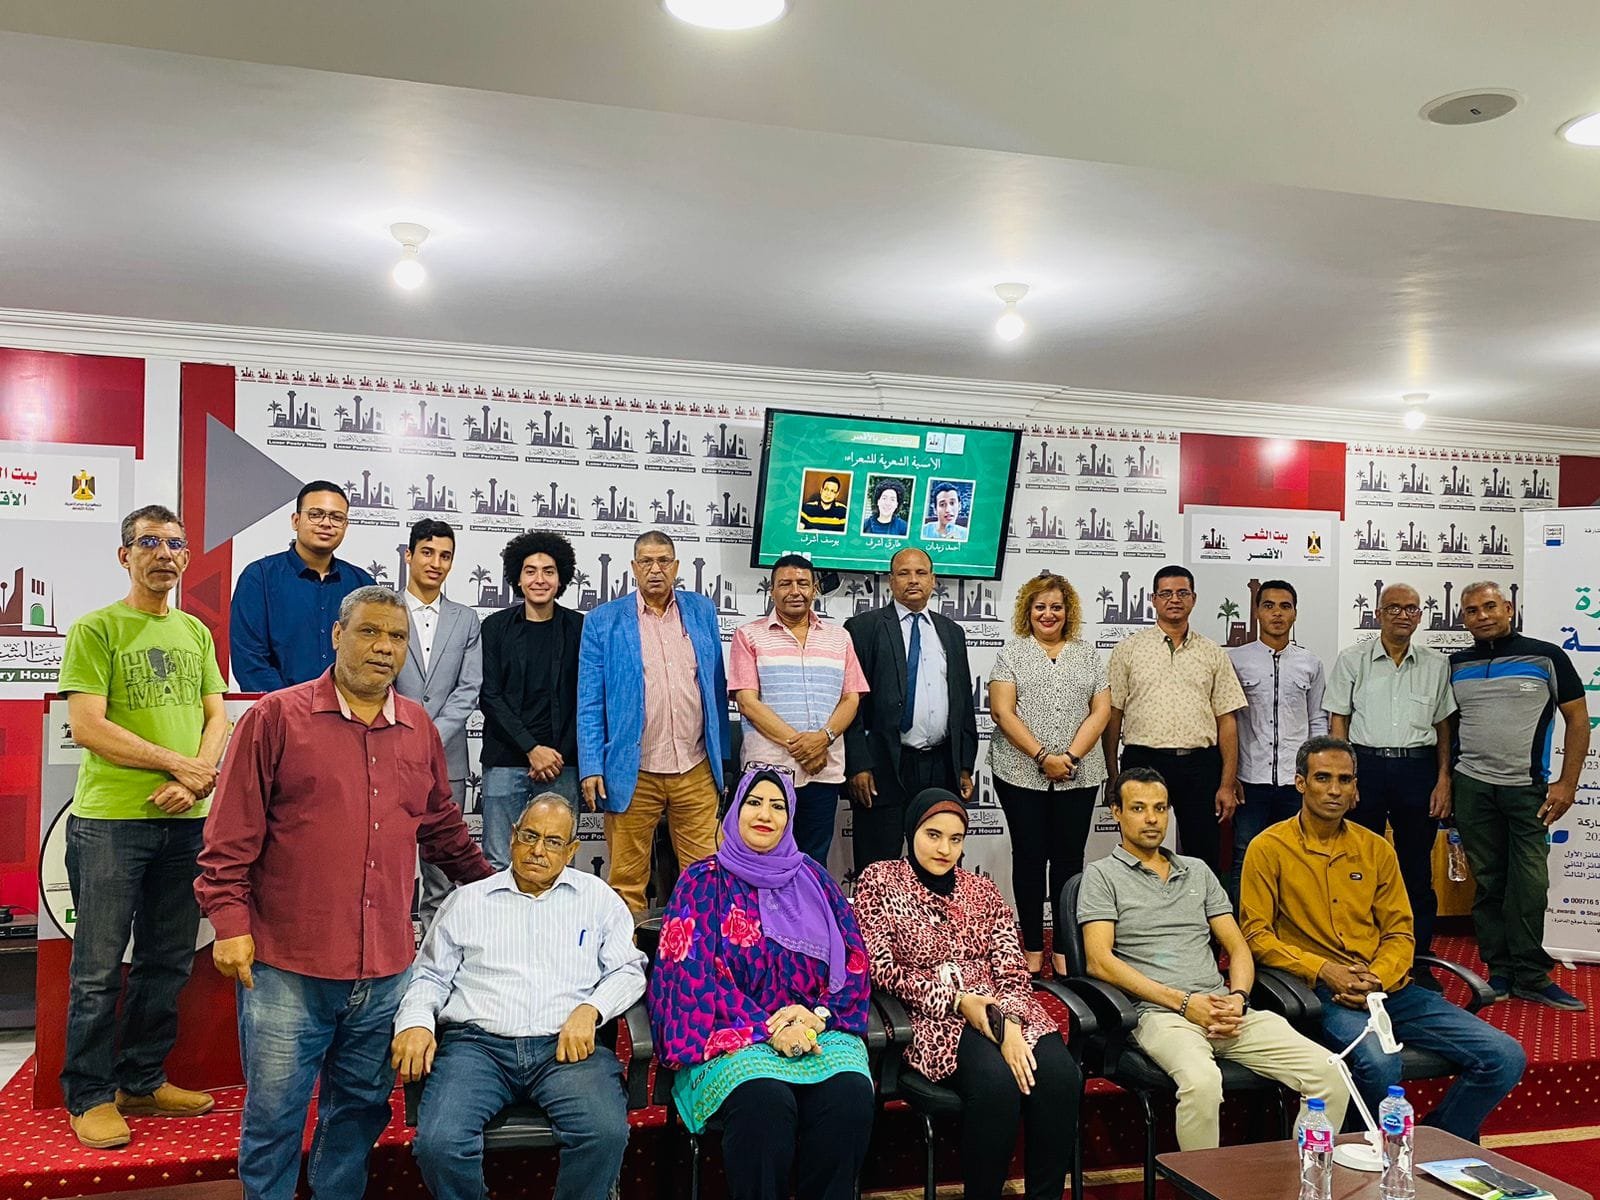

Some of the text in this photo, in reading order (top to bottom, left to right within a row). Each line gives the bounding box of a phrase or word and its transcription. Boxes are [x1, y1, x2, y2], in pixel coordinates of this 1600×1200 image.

[11, 467, 38, 486] بيت
[0, 490, 27, 506] الأق
[1241, 528, 1289, 544] بيت الشعر
[20, 670, 60, 680] Hous
